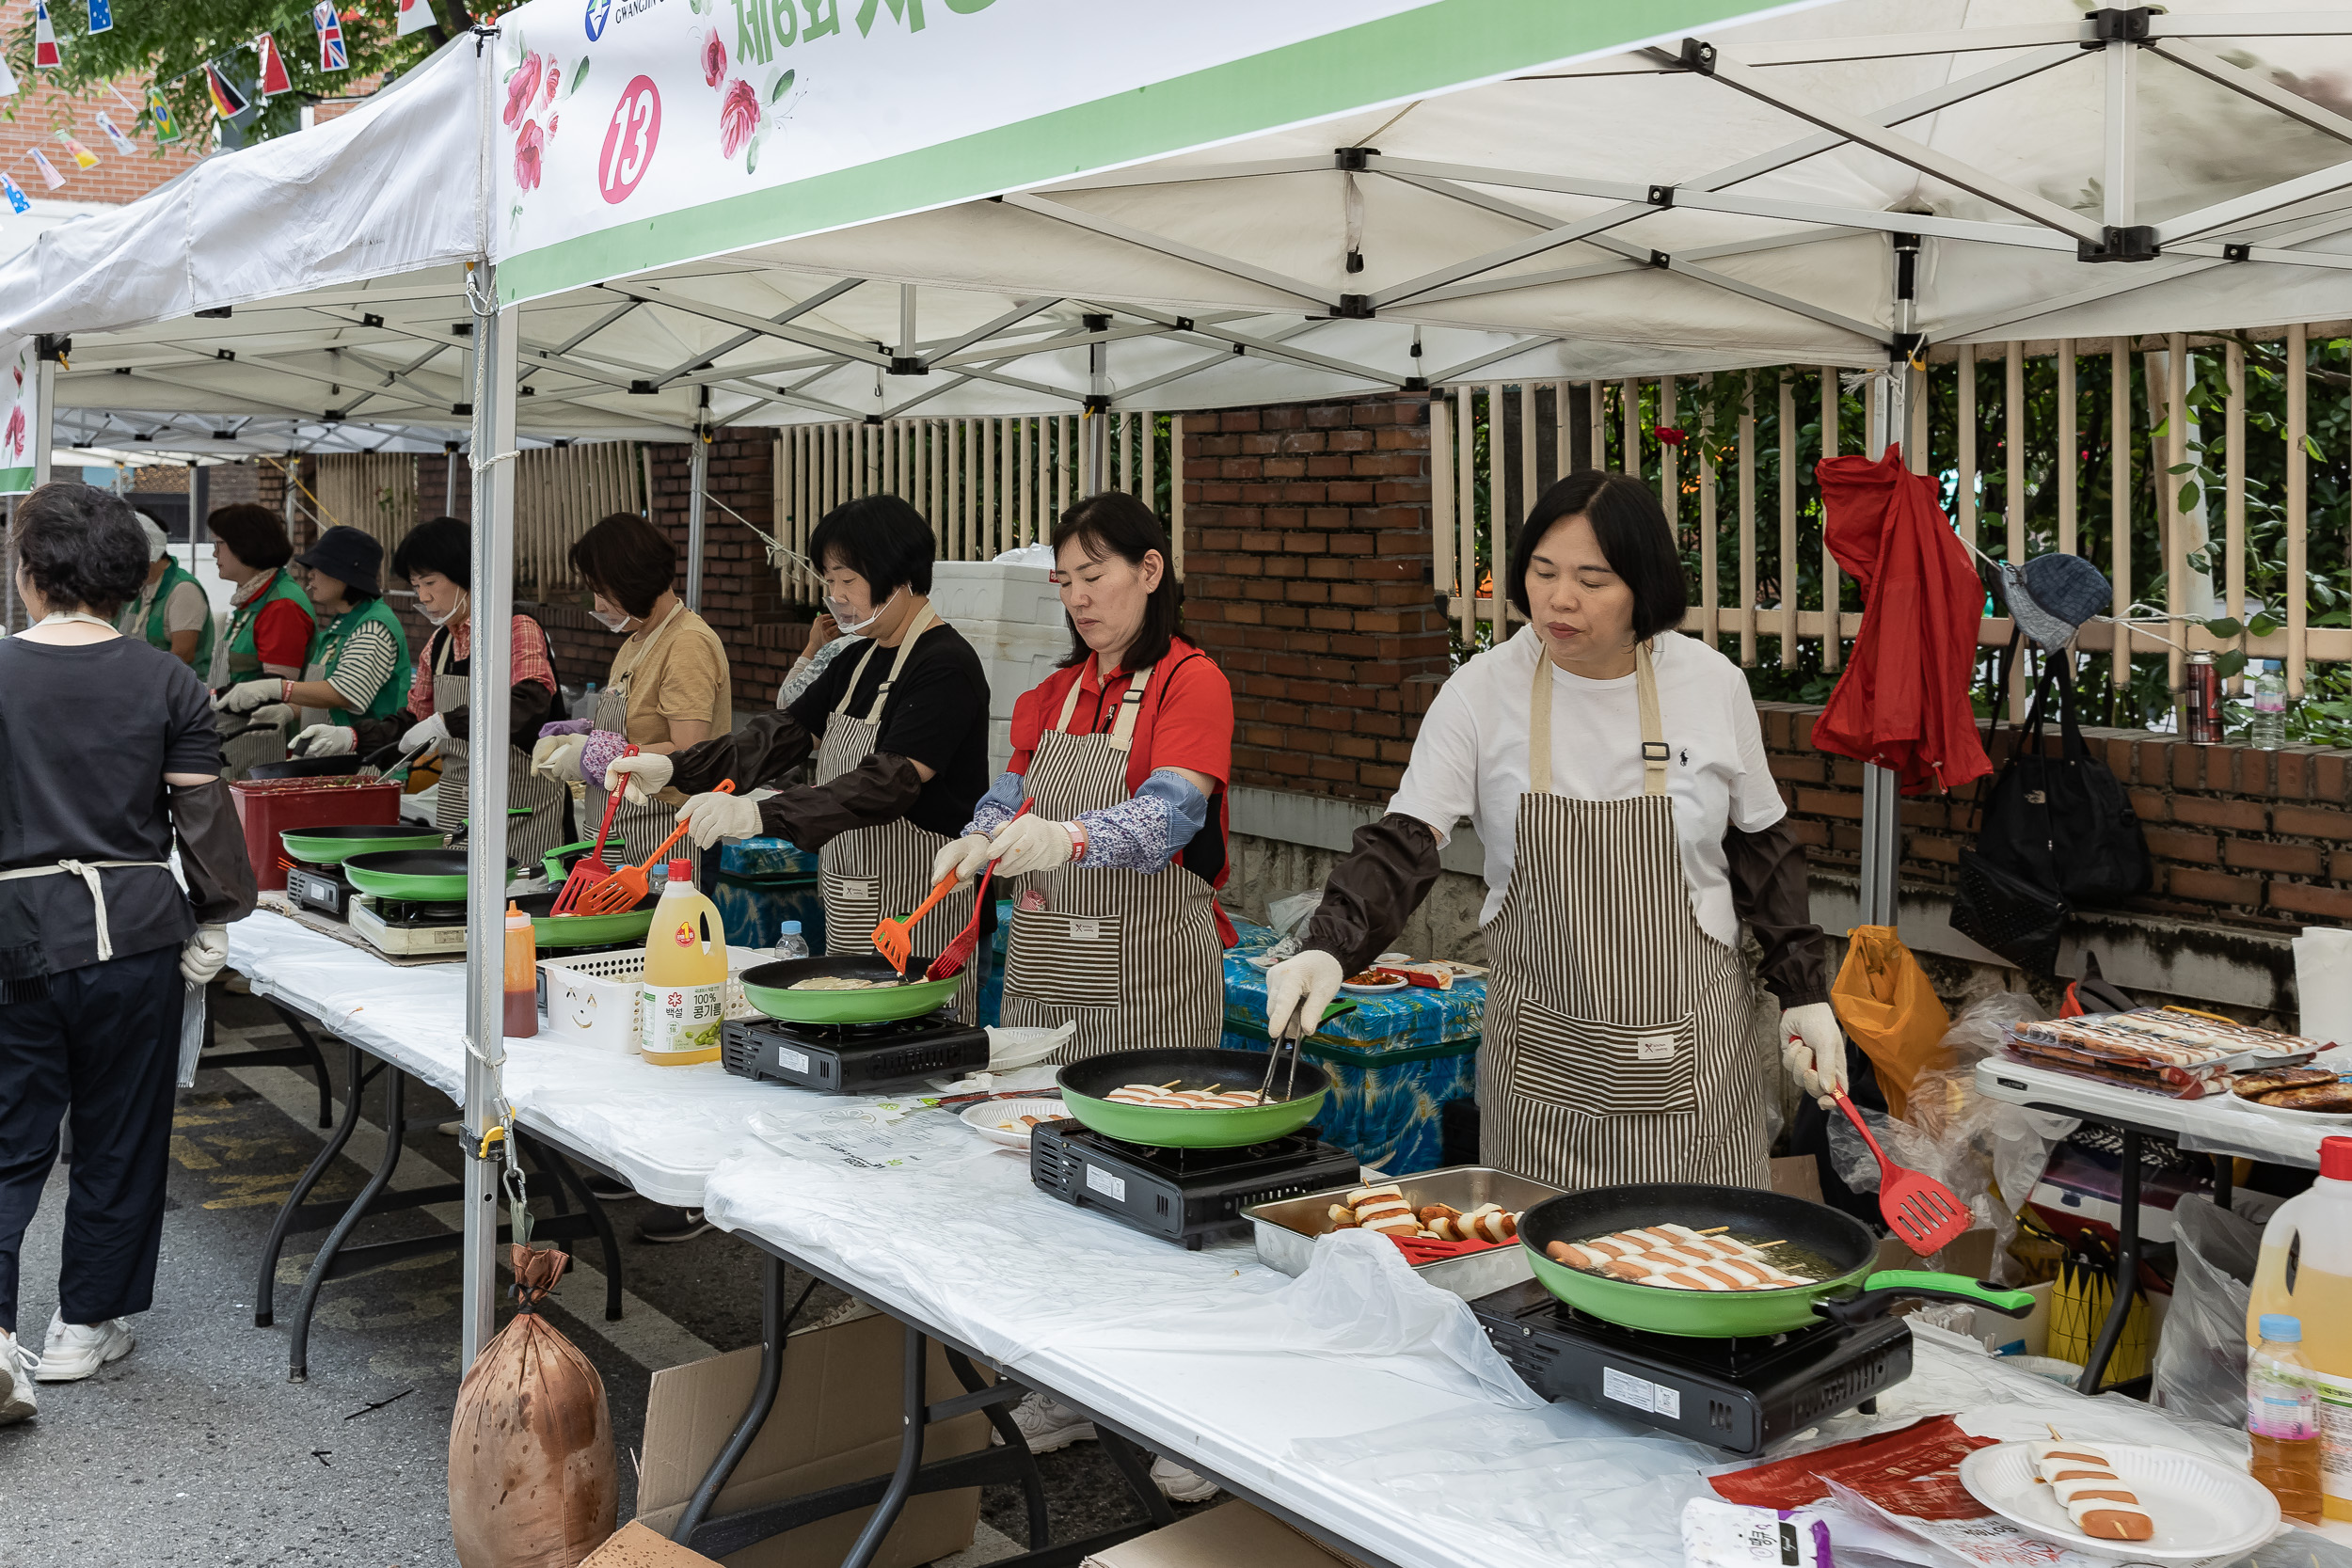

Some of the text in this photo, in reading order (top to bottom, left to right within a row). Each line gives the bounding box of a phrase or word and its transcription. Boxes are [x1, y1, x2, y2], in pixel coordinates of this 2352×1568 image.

[605, 88, 654, 192] 13
[693, 992, 716, 1005] 100%
[665, 1007, 683, 1019] 백설
[693, 1003, 722, 1019] 콩기름
